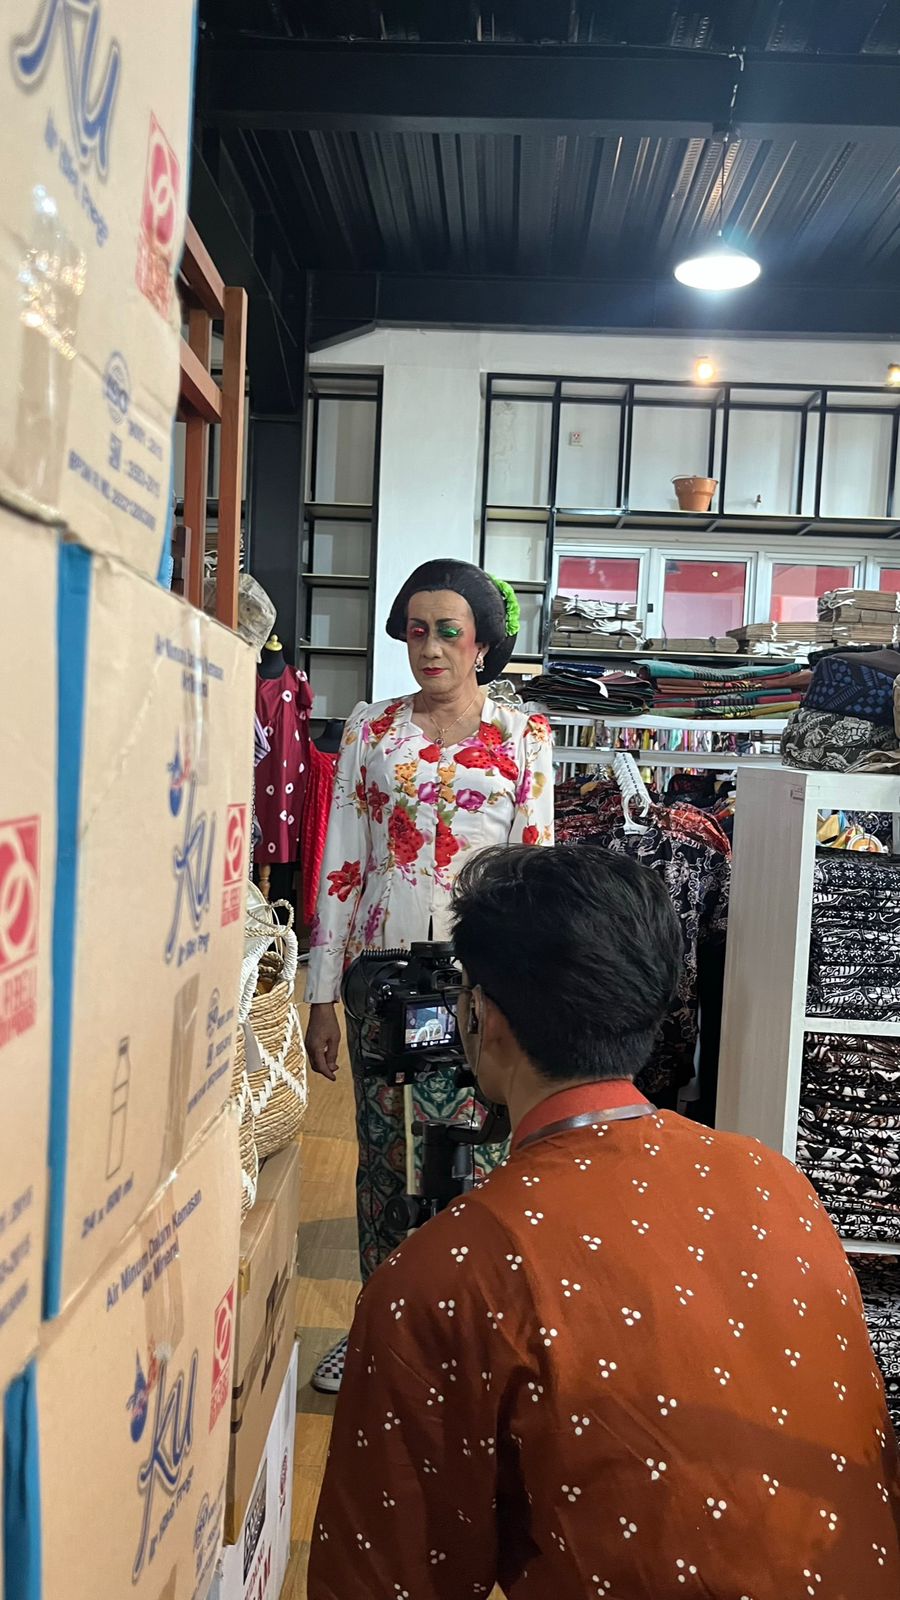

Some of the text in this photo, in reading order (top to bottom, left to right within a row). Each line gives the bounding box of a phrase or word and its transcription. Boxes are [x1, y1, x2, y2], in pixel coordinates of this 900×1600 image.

[106, 1189, 202, 1312] Air Minum Dalam Kemasan
[142, 1235, 179, 1298] Air Mineral
